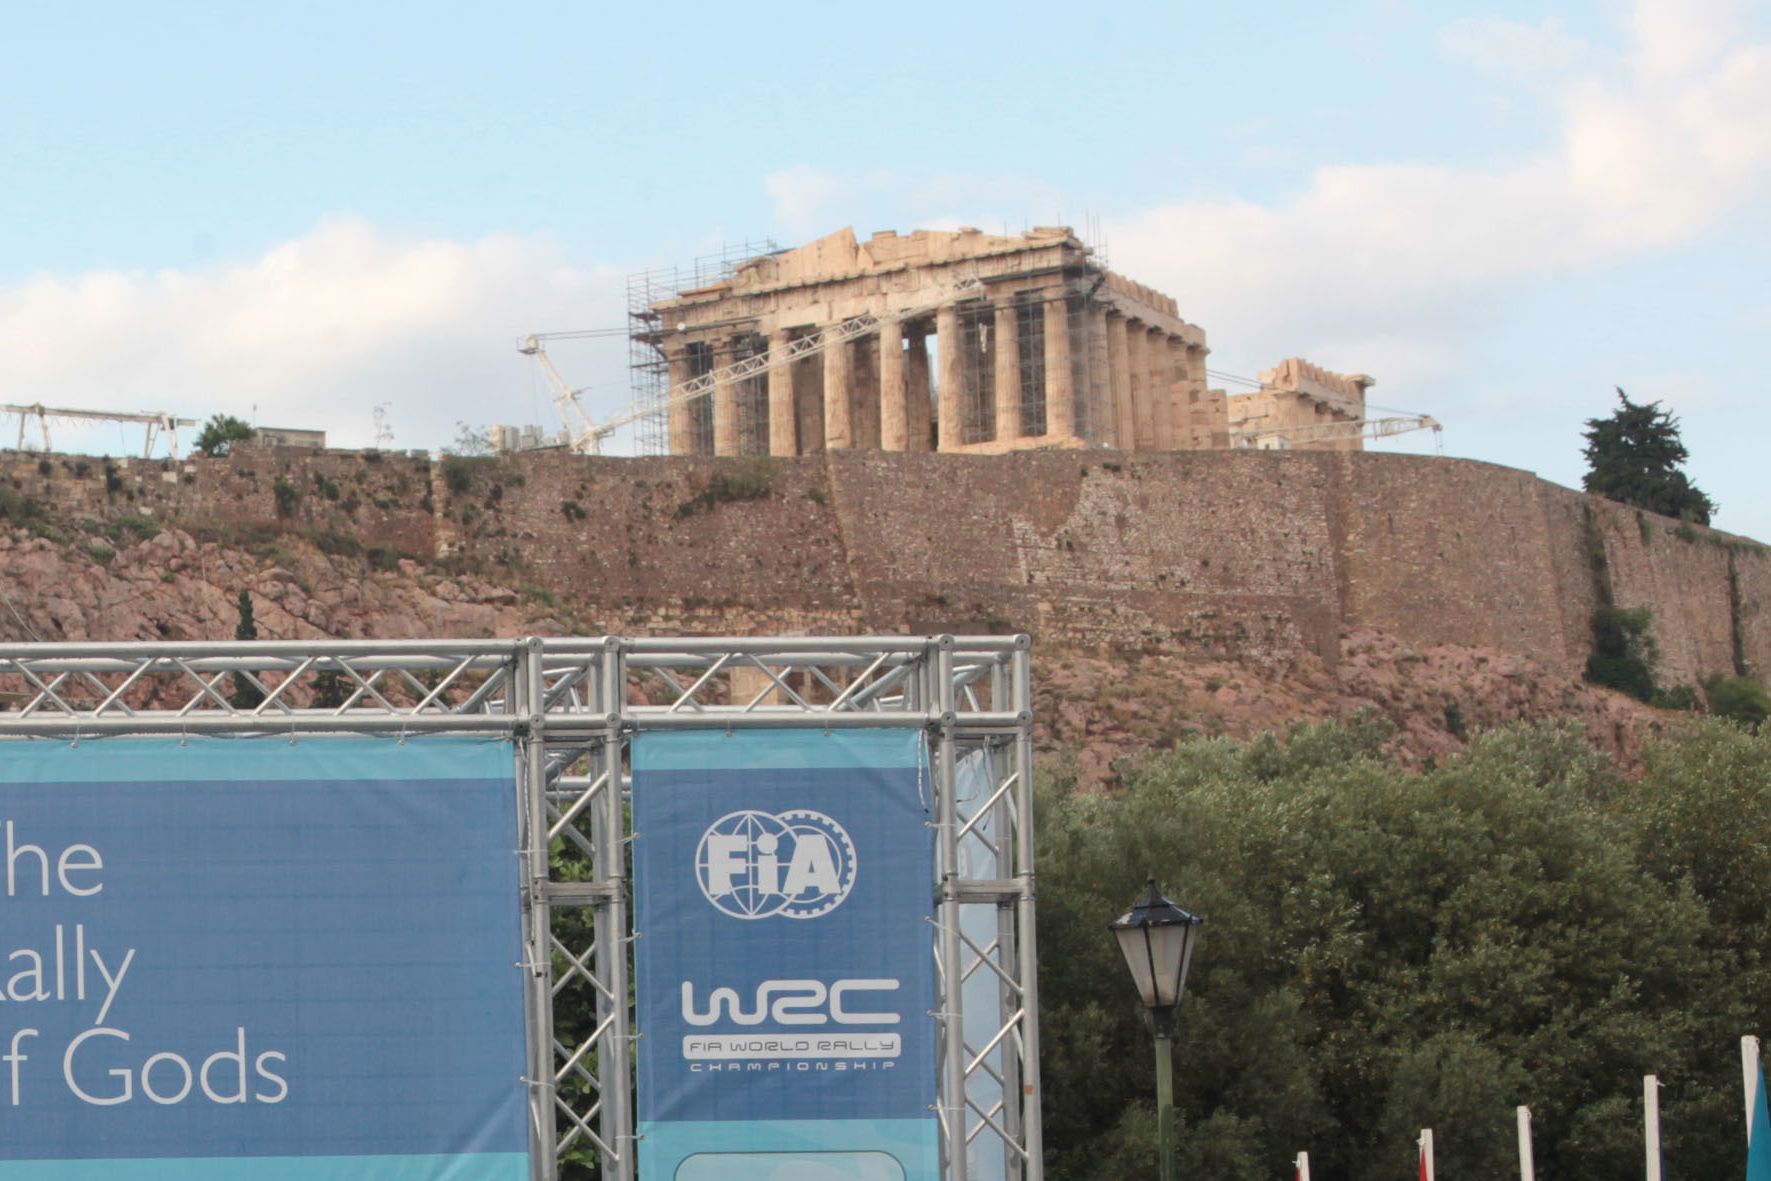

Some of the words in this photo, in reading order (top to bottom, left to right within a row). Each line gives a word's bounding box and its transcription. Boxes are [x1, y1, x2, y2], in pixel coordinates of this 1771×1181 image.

[681, 978, 901, 1026] WRC
[690, 1042, 722, 1052] FIA
[730, 1041, 809, 1052] WORLD
[817, 1040, 894, 1051] RALLY
[62, 1025, 289, 1106] Gods
[690, 1061, 895, 1073] CHAMPIONSHIP
